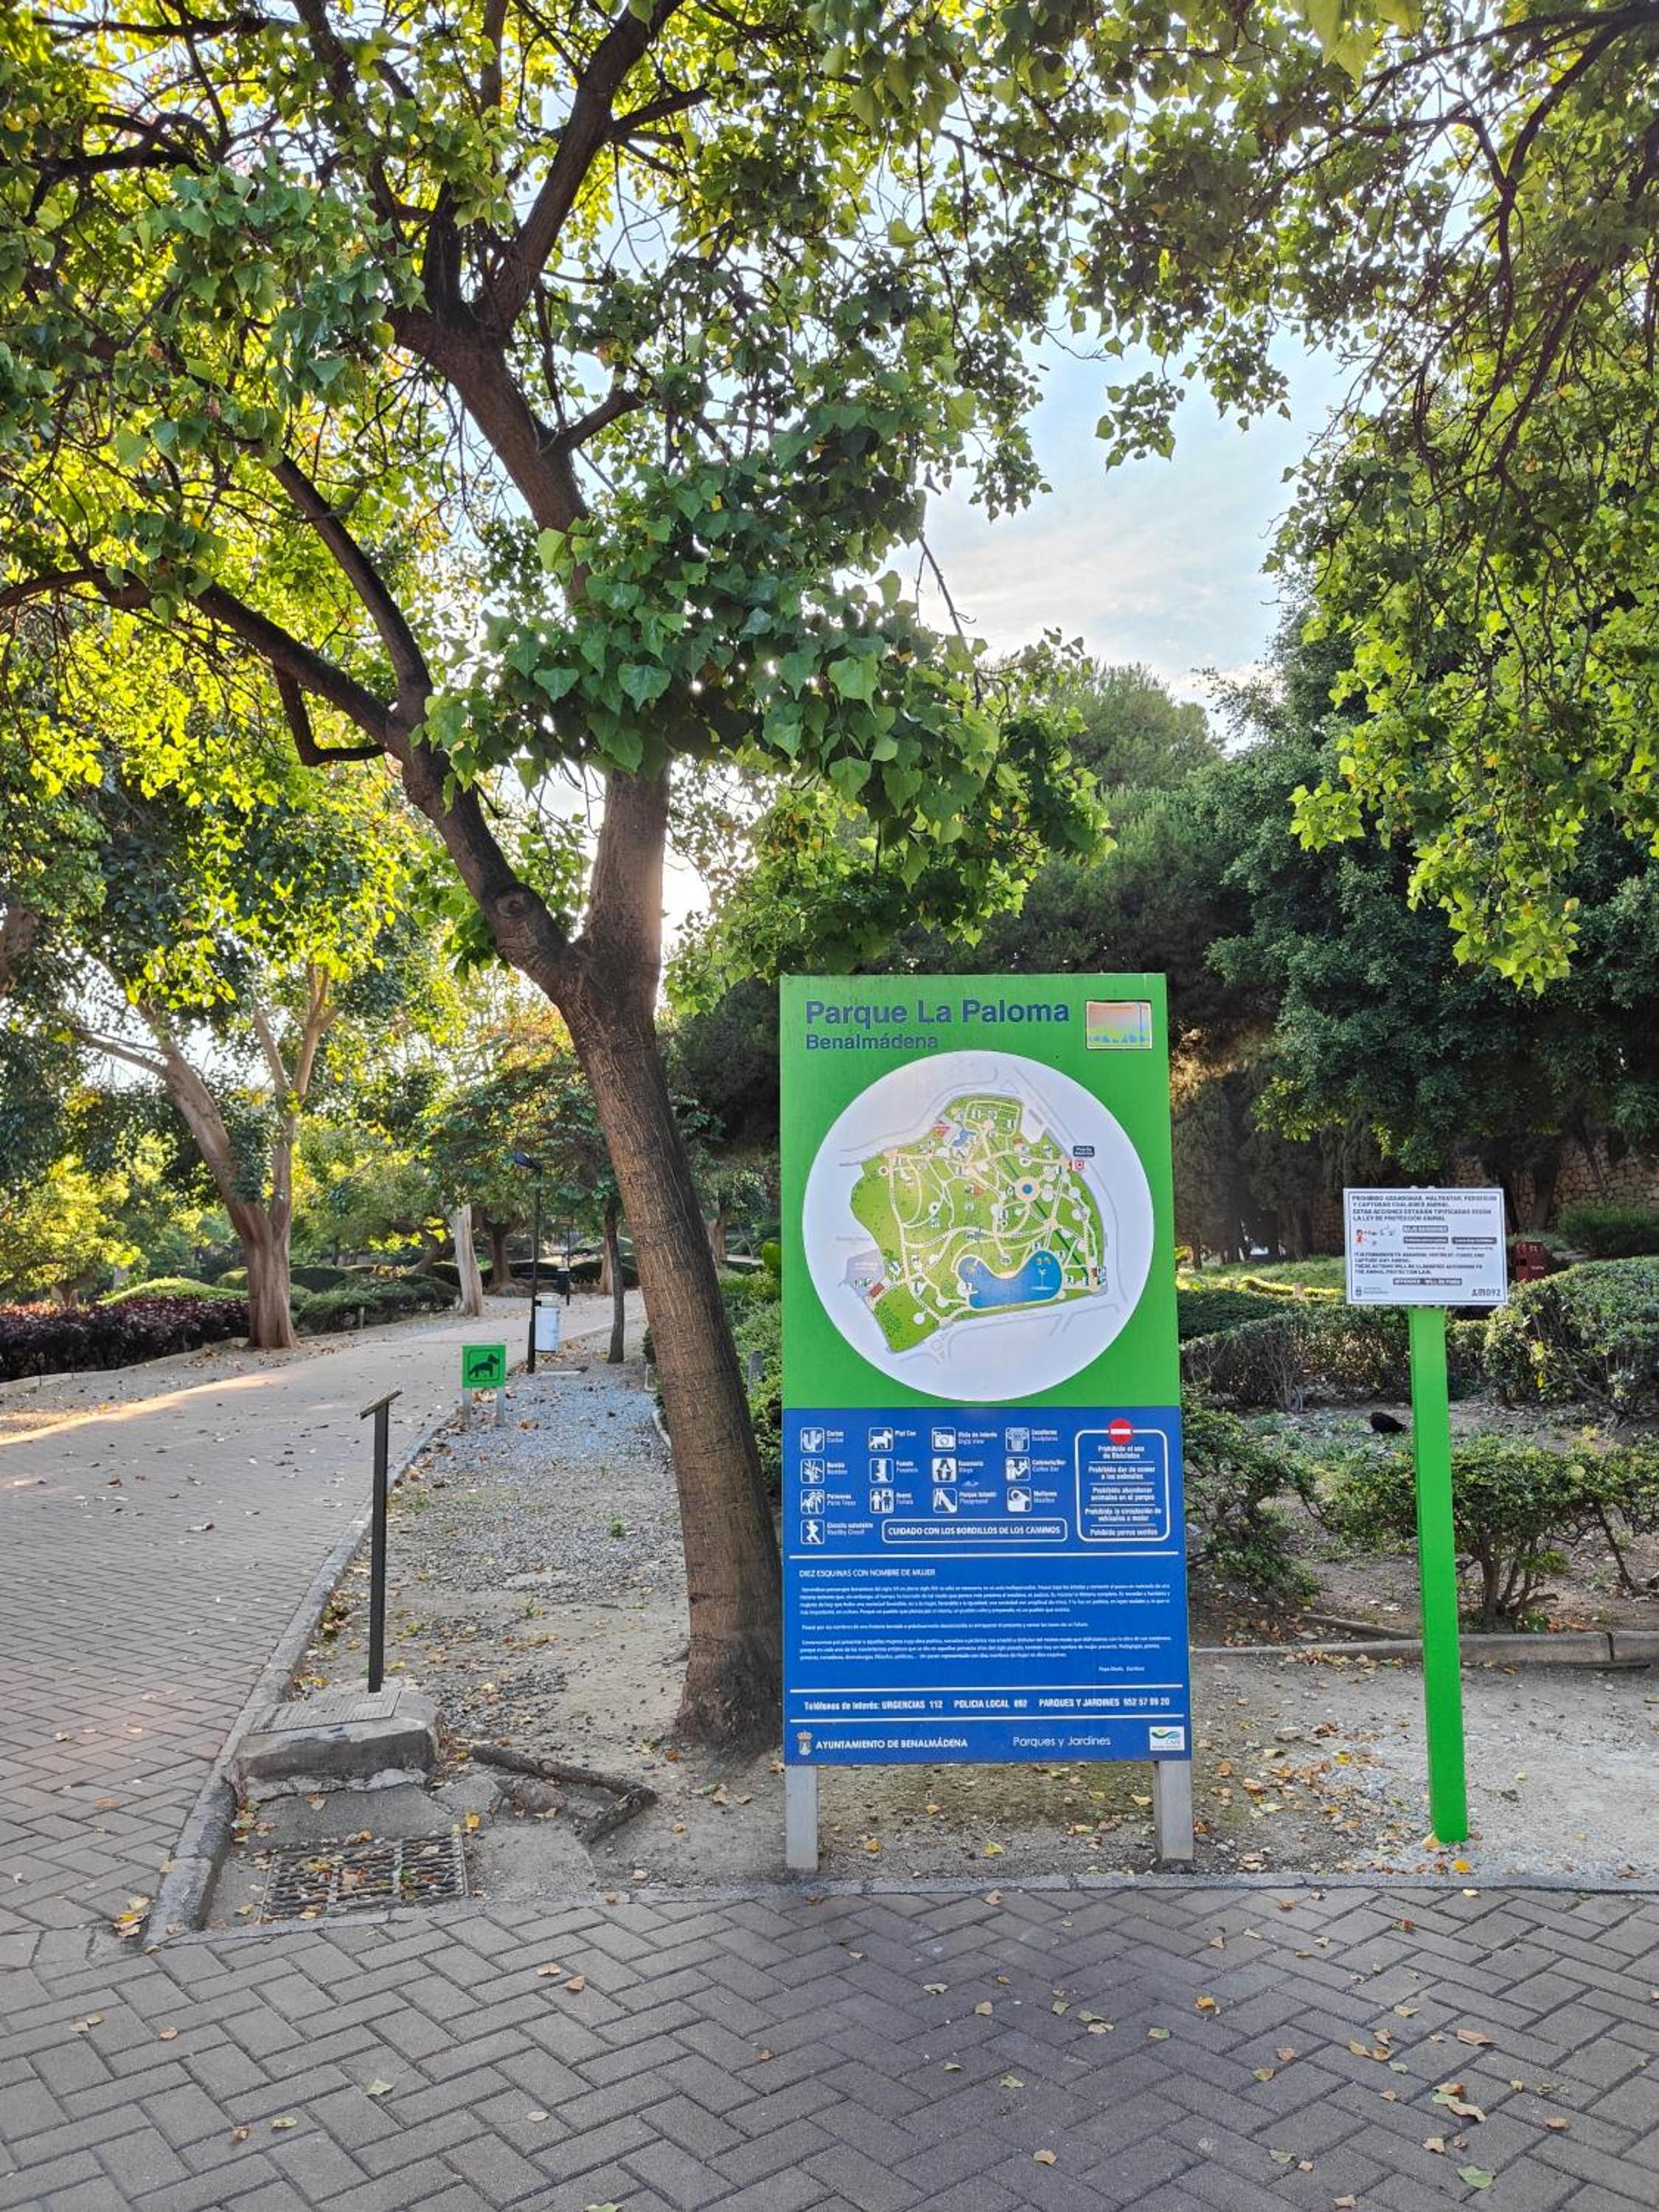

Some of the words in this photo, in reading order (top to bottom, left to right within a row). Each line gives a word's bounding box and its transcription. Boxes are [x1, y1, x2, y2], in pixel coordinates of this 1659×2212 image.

[806, 1001, 908, 1029] Parque
[918, 1000, 952, 1023] La
[962, 999, 1069, 1023] Paloma
[806, 1032, 939, 1050] Benalmádena
[799, 1569, 815, 1577] DIEZ
[816, 1569, 852, 1577] ESQUINAS
[852, 1569, 869, 1577] CON
[870, 1569, 900, 1577] NOMBRE
[901, 1569, 911, 1577] DE
[912, 1569, 936, 1577] MUJER
[804, 1701, 840, 1711] Teléfonos
[841, 1701, 851, 1710] de
[881, 1700, 925, 1709] URGENCIAS
[928, 1700, 943, 1708] 112
[953, 1700, 984, 1708] POLICIA
[985, 1699, 1010, 1708] LOCAL
[1039, 1698, 1074, 1707] PARQUES
[1076, 1698, 1082, 1707] Y
[1082, 1698, 1120, 1707] JARDINES
[1123, 1697, 1137, 1706] 952
[1138, 1697, 1147, 1706] 57
[1160, 1697, 1170, 1705] 20
[815, 1740, 886, 1749] AYUNTAMIENTO
[887, 1739, 899, 1748] DE
[900, 1736, 968, 1748] BENALMÁDENA
[1012, 1736, 1055, 1748] Parques
[1058, 1739, 1065, 1747] y
[1068, 1736, 1111, 1746] Jardines
